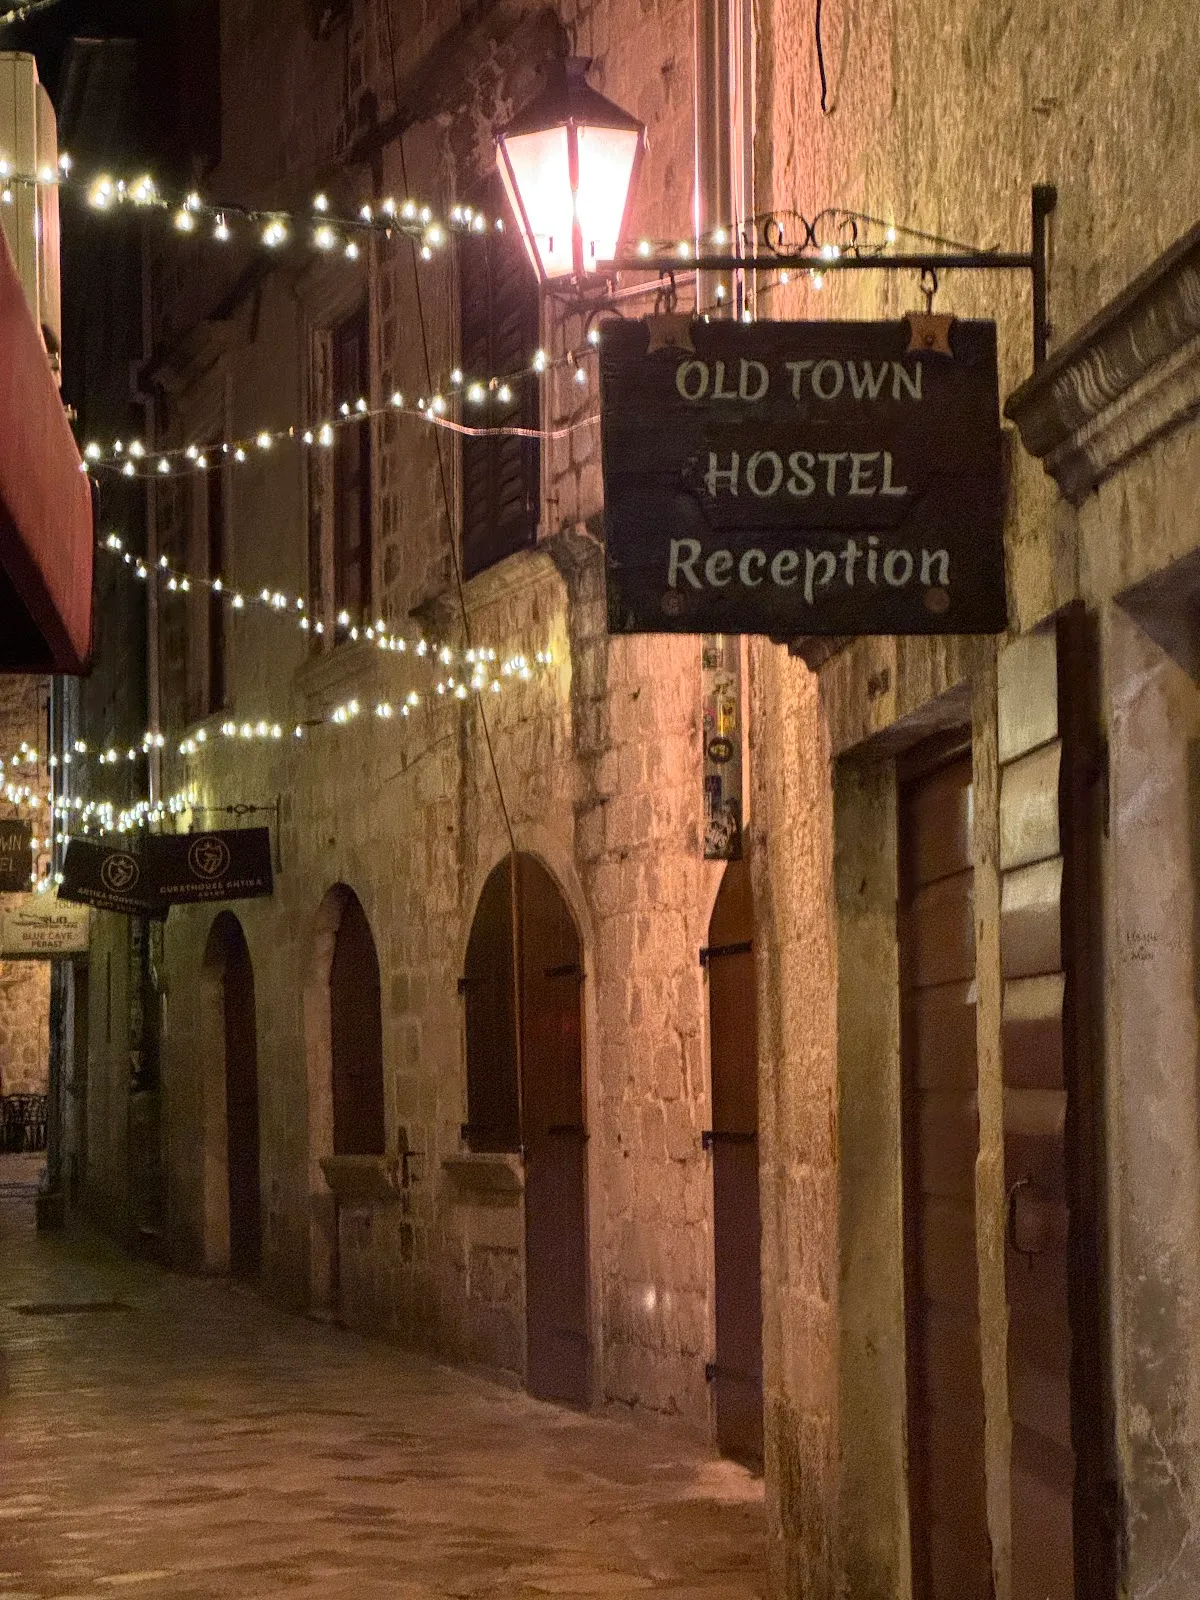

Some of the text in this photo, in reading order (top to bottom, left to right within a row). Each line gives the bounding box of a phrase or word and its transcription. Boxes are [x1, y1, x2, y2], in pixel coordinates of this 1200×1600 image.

[676, 360, 924, 401] OLD TOWN
[704, 450, 908, 498] HOSTEL
[667, 537, 951, 604] Reception
